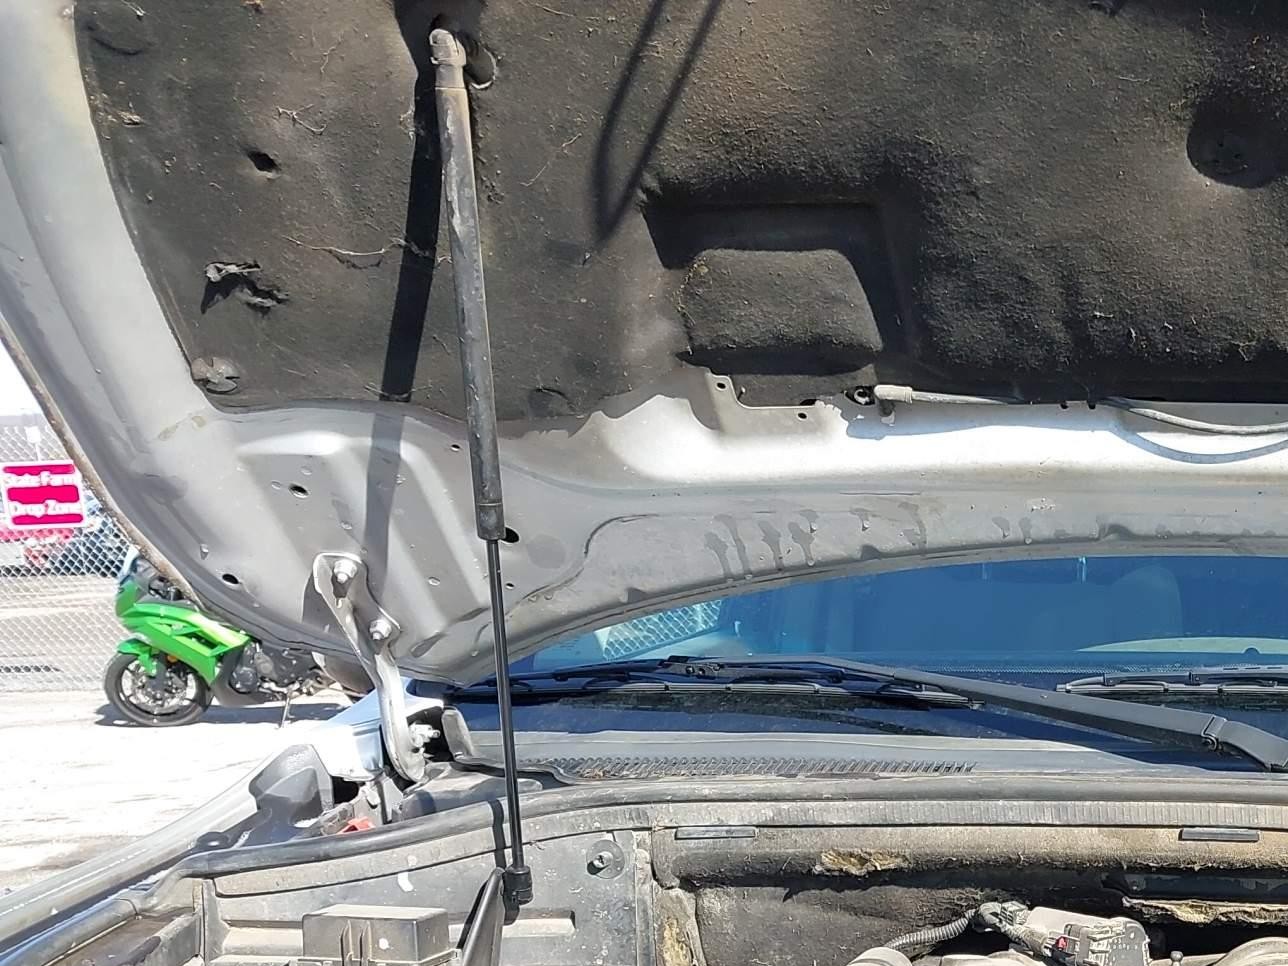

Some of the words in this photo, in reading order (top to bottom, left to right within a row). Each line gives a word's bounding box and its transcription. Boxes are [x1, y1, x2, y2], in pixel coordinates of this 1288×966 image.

[3, 473, 41, 488] State
[8, 502, 45, 517] Drop
[47, 500, 82, 515] Zone
